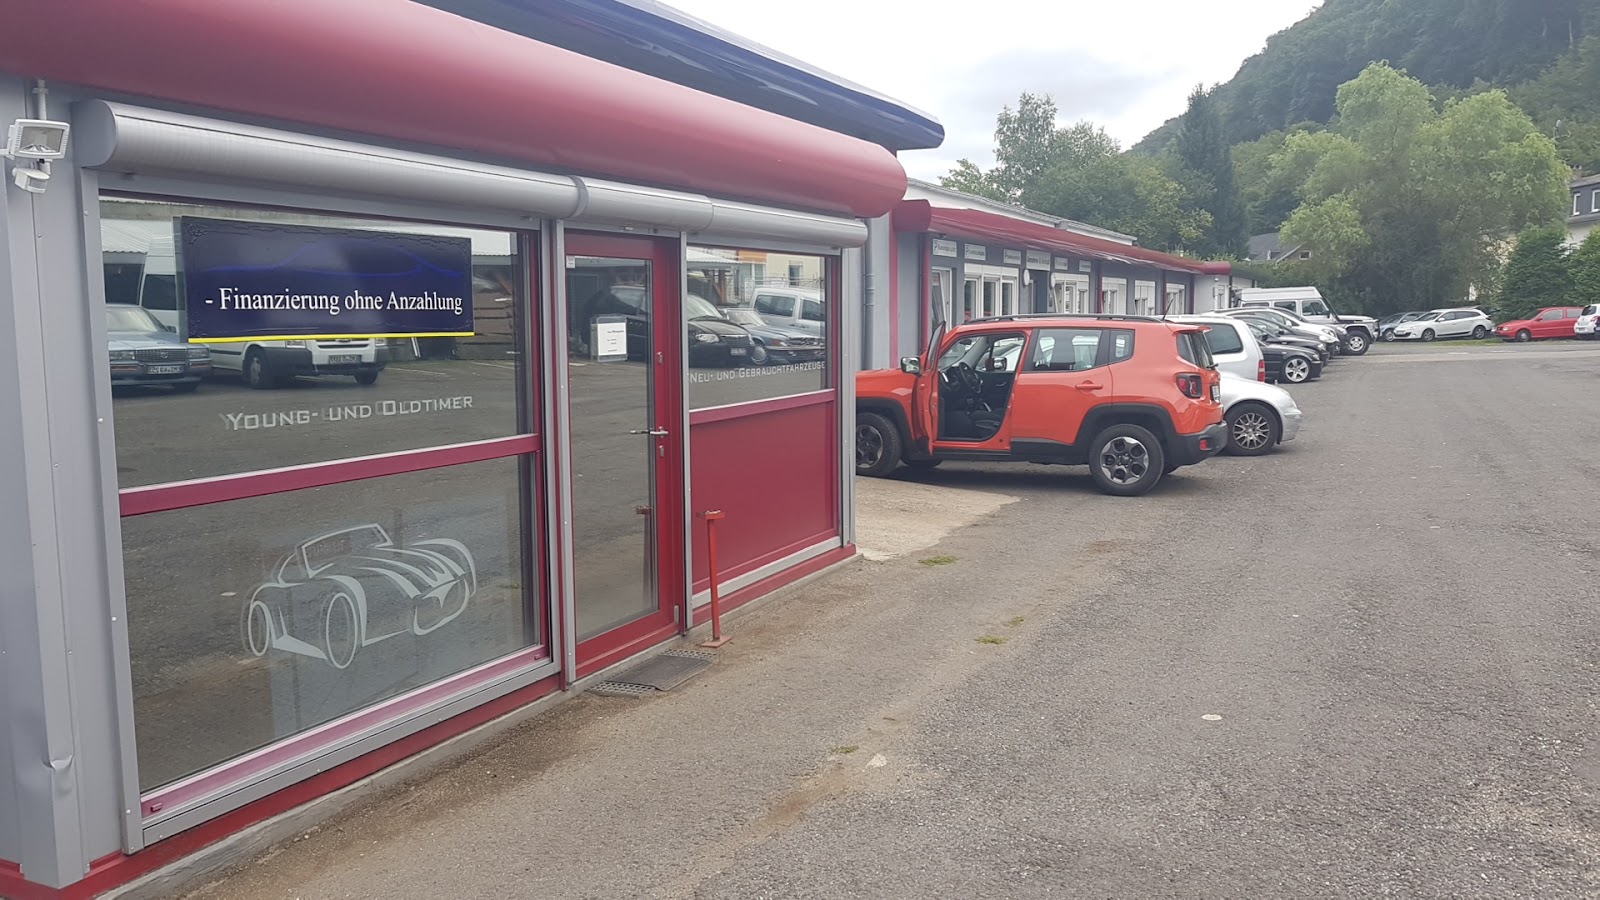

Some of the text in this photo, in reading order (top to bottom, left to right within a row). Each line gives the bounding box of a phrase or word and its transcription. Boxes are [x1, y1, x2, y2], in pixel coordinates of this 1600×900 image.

[219, 287, 340, 315] Finanzierung
[344, 289, 384, 310] ohne
[386, 291, 463, 315] Anzahlung
[716, 370, 736, 381] UND
[328, 405, 372, 421] UND
[382, 395, 473, 416] OLDTIMER
